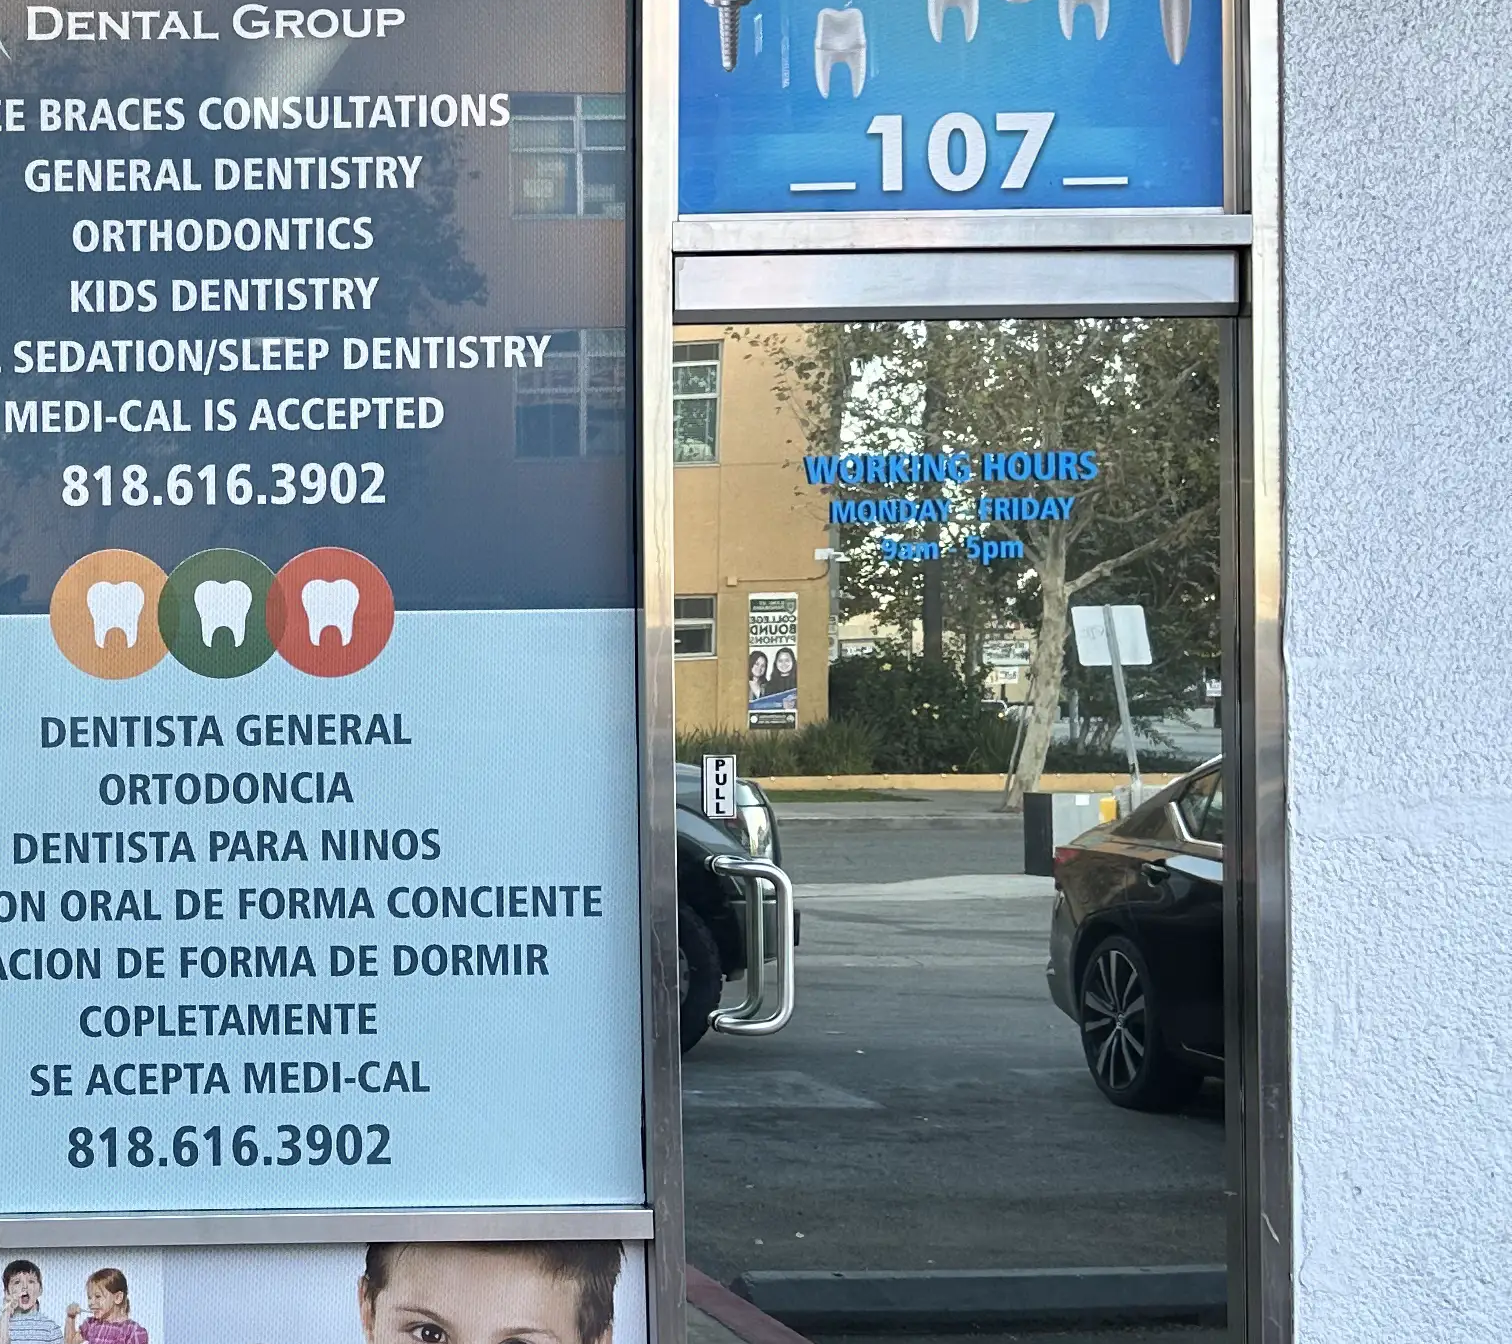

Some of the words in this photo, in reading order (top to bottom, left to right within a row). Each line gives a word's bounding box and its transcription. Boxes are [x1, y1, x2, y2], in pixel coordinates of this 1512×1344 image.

[40, 98, 184, 131] BRACES
[198, 93, 510, 130] CONSULTATIONS
[867, 112, 1054, 191] 107
[25, 159, 201, 192] GENERAL
[215, 156, 422, 190] DENTISTRY
[73, 217, 373, 252] ORTHODONTICS
[71, 280, 157, 312] KIDS
[173, 277, 379, 311] DENTISTRY
[14, 338, 329, 375] SEDATION/SLEEP
[344, 335, 550, 369] DENTISTRY
[5, 400, 191, 432] MEDI-CAL
[205, 399, 236, 431] IS
[249, 397, 444, 430] ACCEPTED
[62, 462, 385, 506] 818.616.3902
[804, 452, 971, 485] WORKING
[983, 451, 1098, 482] HOURS
[830, 499, 949, 524] MONDAY
[978, 497, 1075, 522] FRIDAY
[882, 538, 938, 561] 9am
[967, 536, 1024, 564] 5pm
[41, 715, 223, 748] DENTISTA
[236, 714, 411, 746] GENERAL
[99, 772, 353, 805] ORTODONCIA
[715, 759, 727, 814] PULL
[14, 831, 196, 864] DENTISTA
[210, 830, 308, 862] PARA
[322, 828, 440, 860] NINOS
[61, 890, 161, 922] ORAL
[176, 889, 223, 920] DE
[239, 888, 375, 919] FORMA
[387, 886, 602, 918] CONCIENTE
[117, 947, 165, 979] DE
[180, 946, 316, 978] FORMA
[330, 945, 378, 976] DE
[394, 944, 548, 976] DORMIR
[80, 1003, 377, 1037] COPLETAMENTE
[31, 1065, 72, 1096] SE
[86, 1063, 230, 1095] ACEPTA
[244, 1061, 430, 1093] MEDI-CAL
[68, 1124, 391, 1168] 818.616.3902
